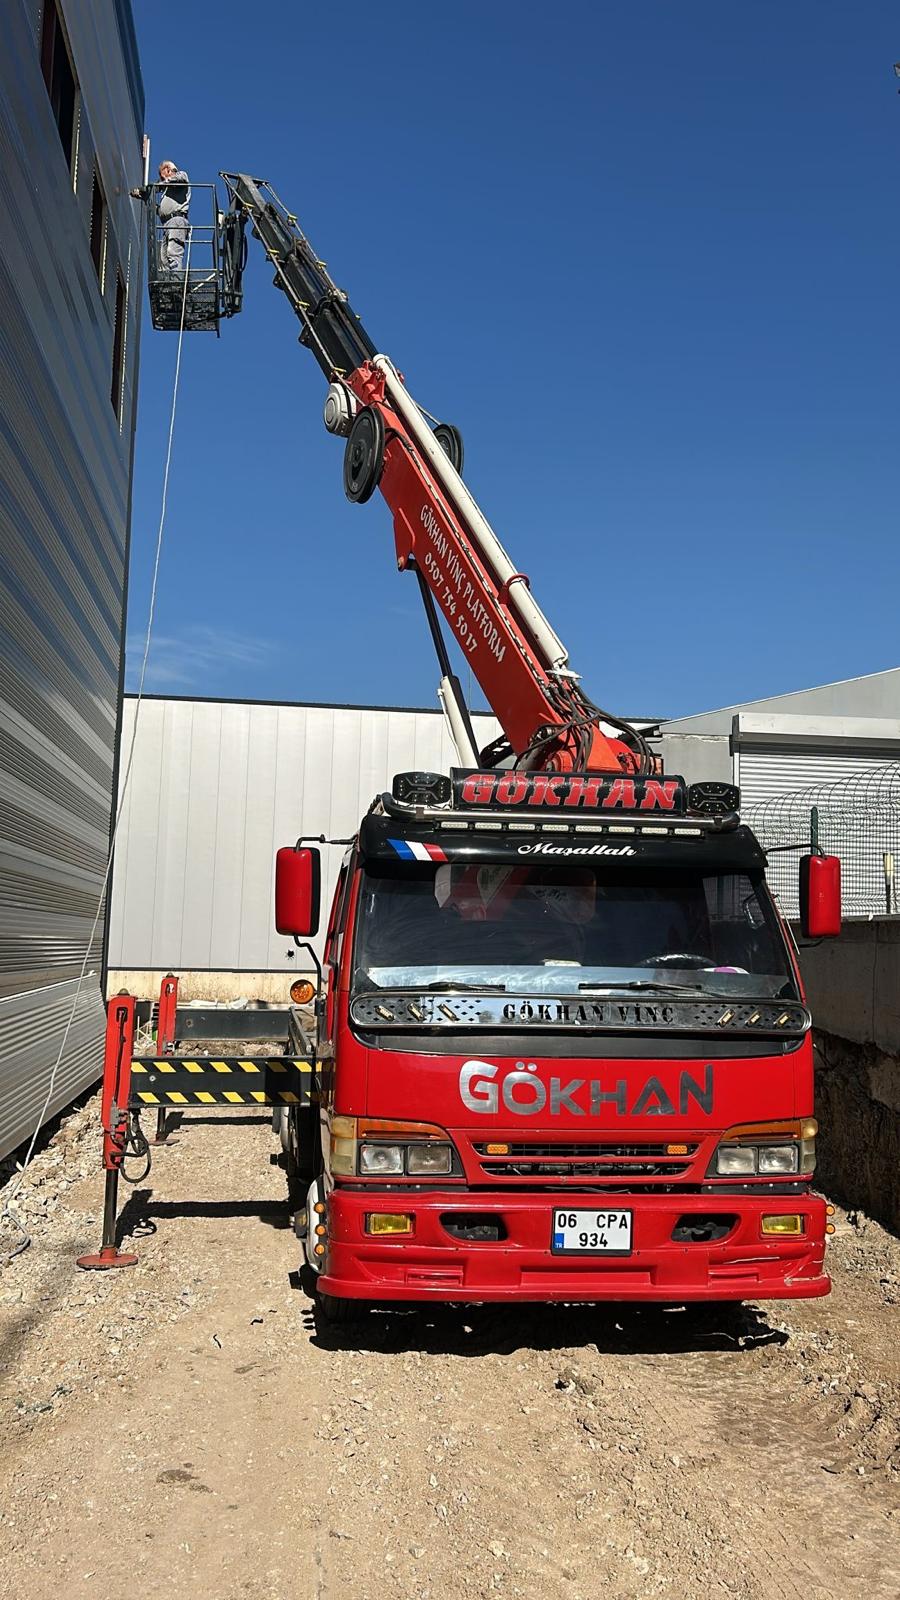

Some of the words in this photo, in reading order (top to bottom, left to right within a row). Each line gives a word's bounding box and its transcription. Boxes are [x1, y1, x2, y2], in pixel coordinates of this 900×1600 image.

[420, 504, 449, 559] GÖKHAN
[446, 549, 466, 594] VİNÇ
[462, 582, 507, 663] PLATFORM
[425, 552, 444, 588] 0507
[442, 586, 457, 616] 754
[460, 771, 682, 810] GÖKHAN
[502, 1000, 604, 1022] GÖKHAN
[618, 1003, 674, 1024] VİNÇ
[458, 1060, 715, 1116] GÖKHAN
[557, 1213, 578, 1228] 06
[596, 1214, 628, 1229] CPA
[579, 1232, 608, 1248] 934
